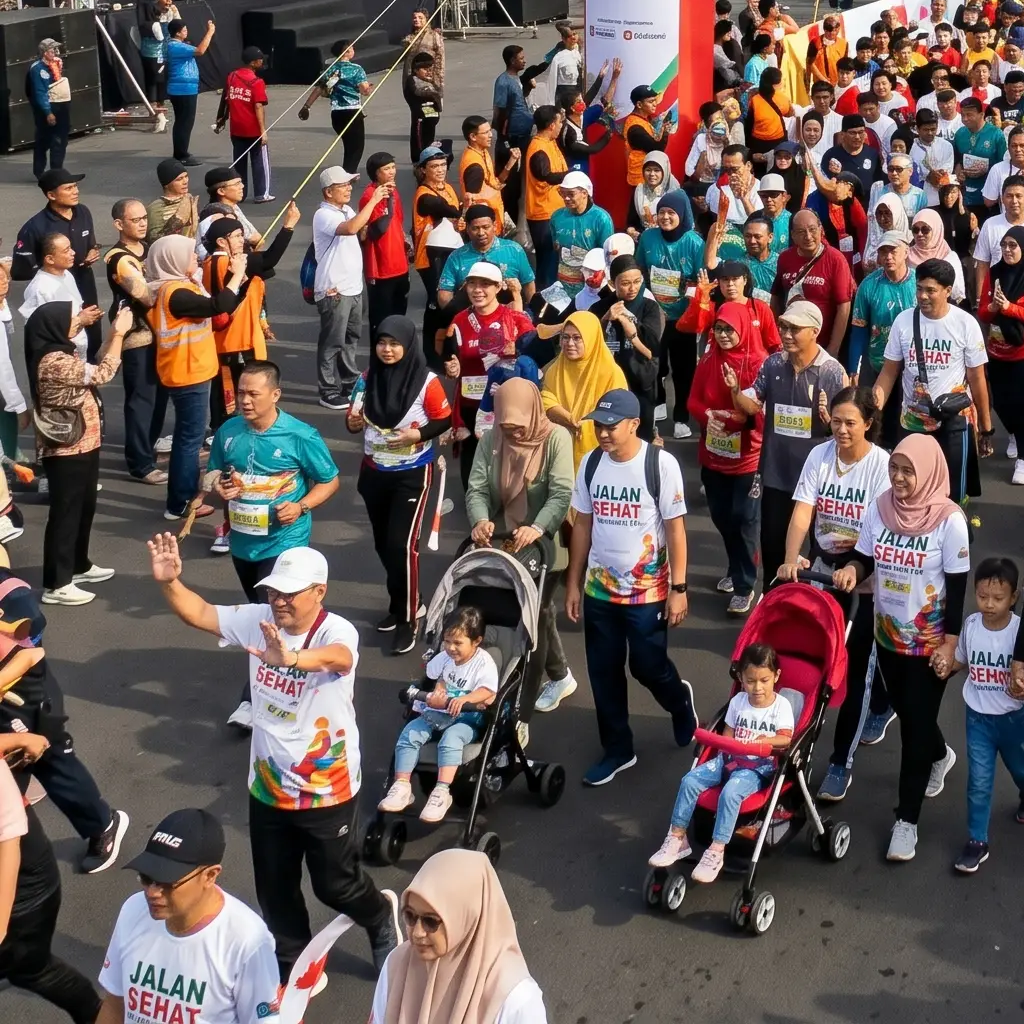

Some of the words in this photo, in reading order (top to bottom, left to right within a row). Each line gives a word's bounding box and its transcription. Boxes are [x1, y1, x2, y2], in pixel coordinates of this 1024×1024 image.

[593, 484, 641, 503] JALAN
[818, 481, 866, 504] JALAN
[593, 501, 641, 519] SEHAT
[816, 497, 864, 520] SEHAT
[876, 528, 929, 552] JALAN
[874, 544, 927, 569] SEHAT
[256, 665, 306, 698] SEHAT
[130, 961, 207, 1006] JALAN
[128, 986, 202, 1024] SEHAT
